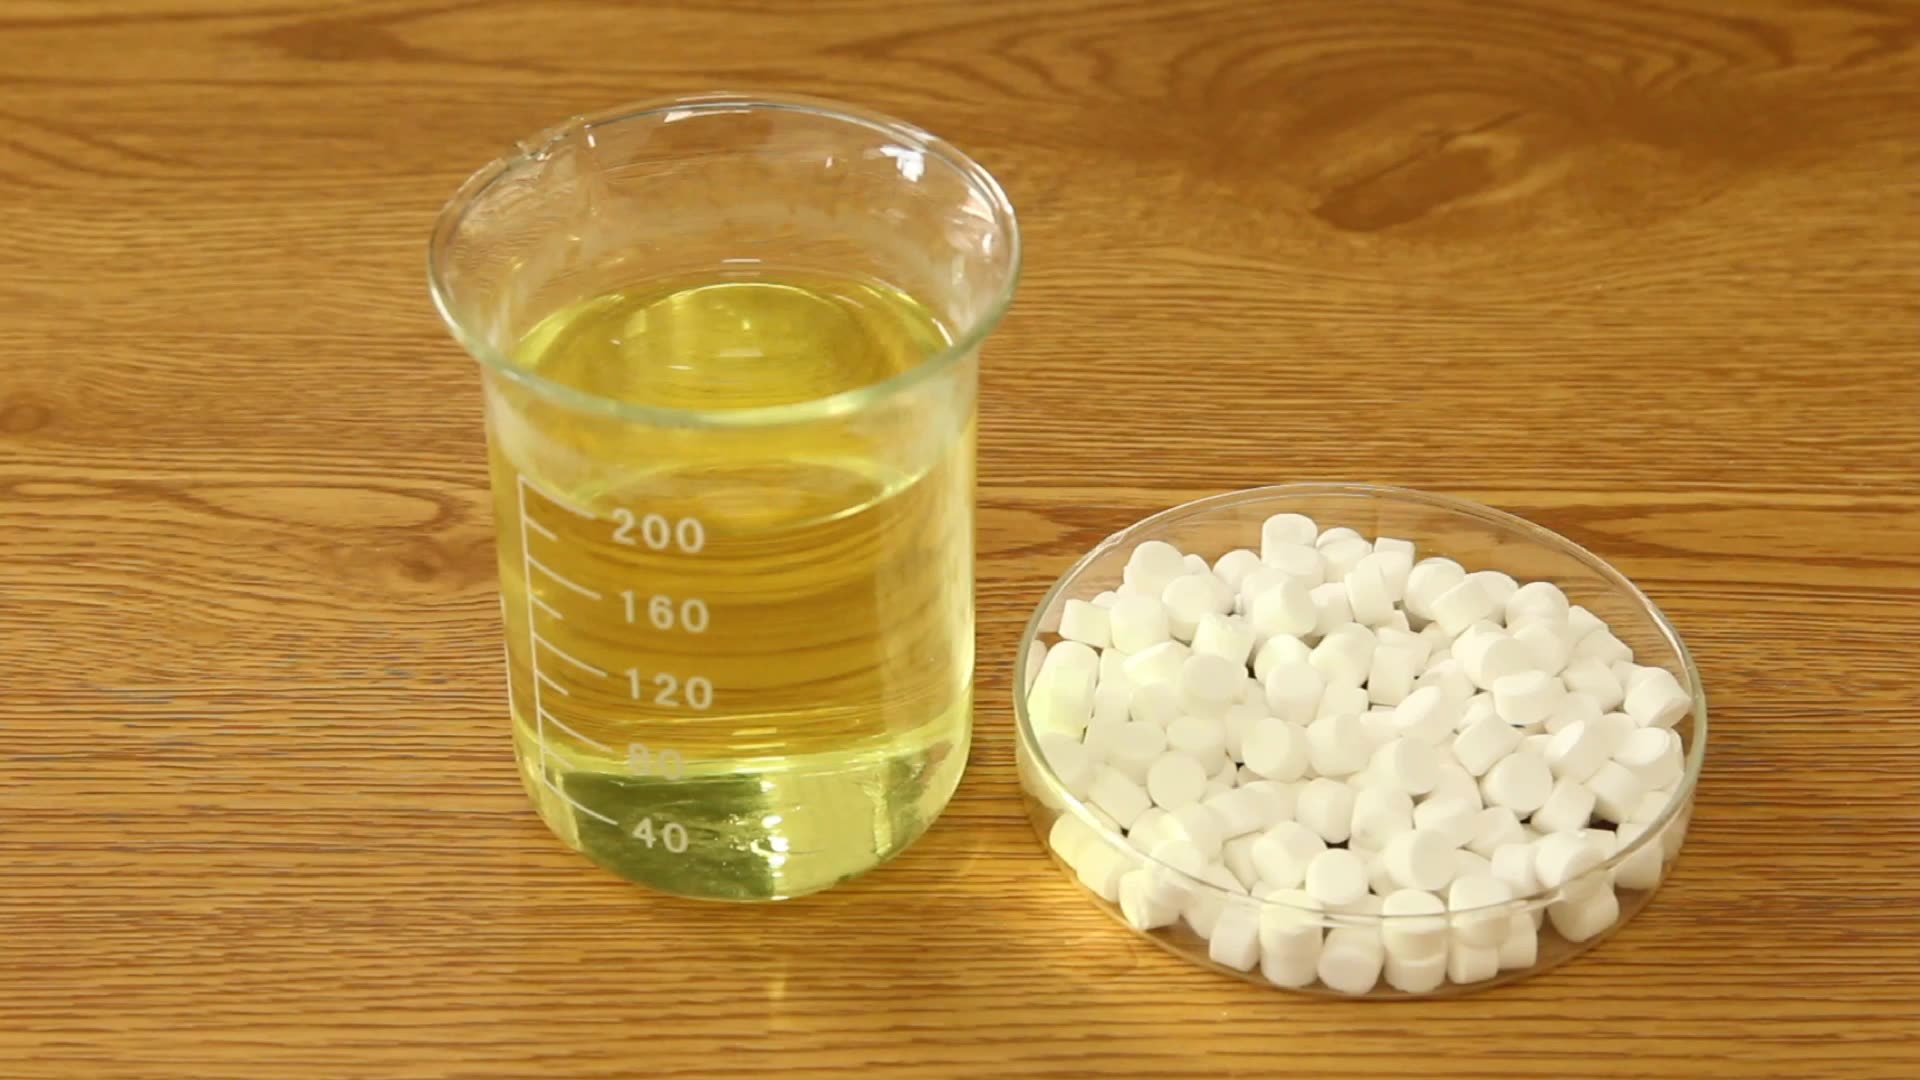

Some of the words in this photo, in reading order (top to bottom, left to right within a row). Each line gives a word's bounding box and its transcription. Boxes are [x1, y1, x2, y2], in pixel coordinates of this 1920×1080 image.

[611, 508, 705, 553] 200
[620, 591, 709, 633] 160
[625, 668, 714, 710] 120
[628, 742, 685, 781] 80
[632, 817, 689, 853] 40
